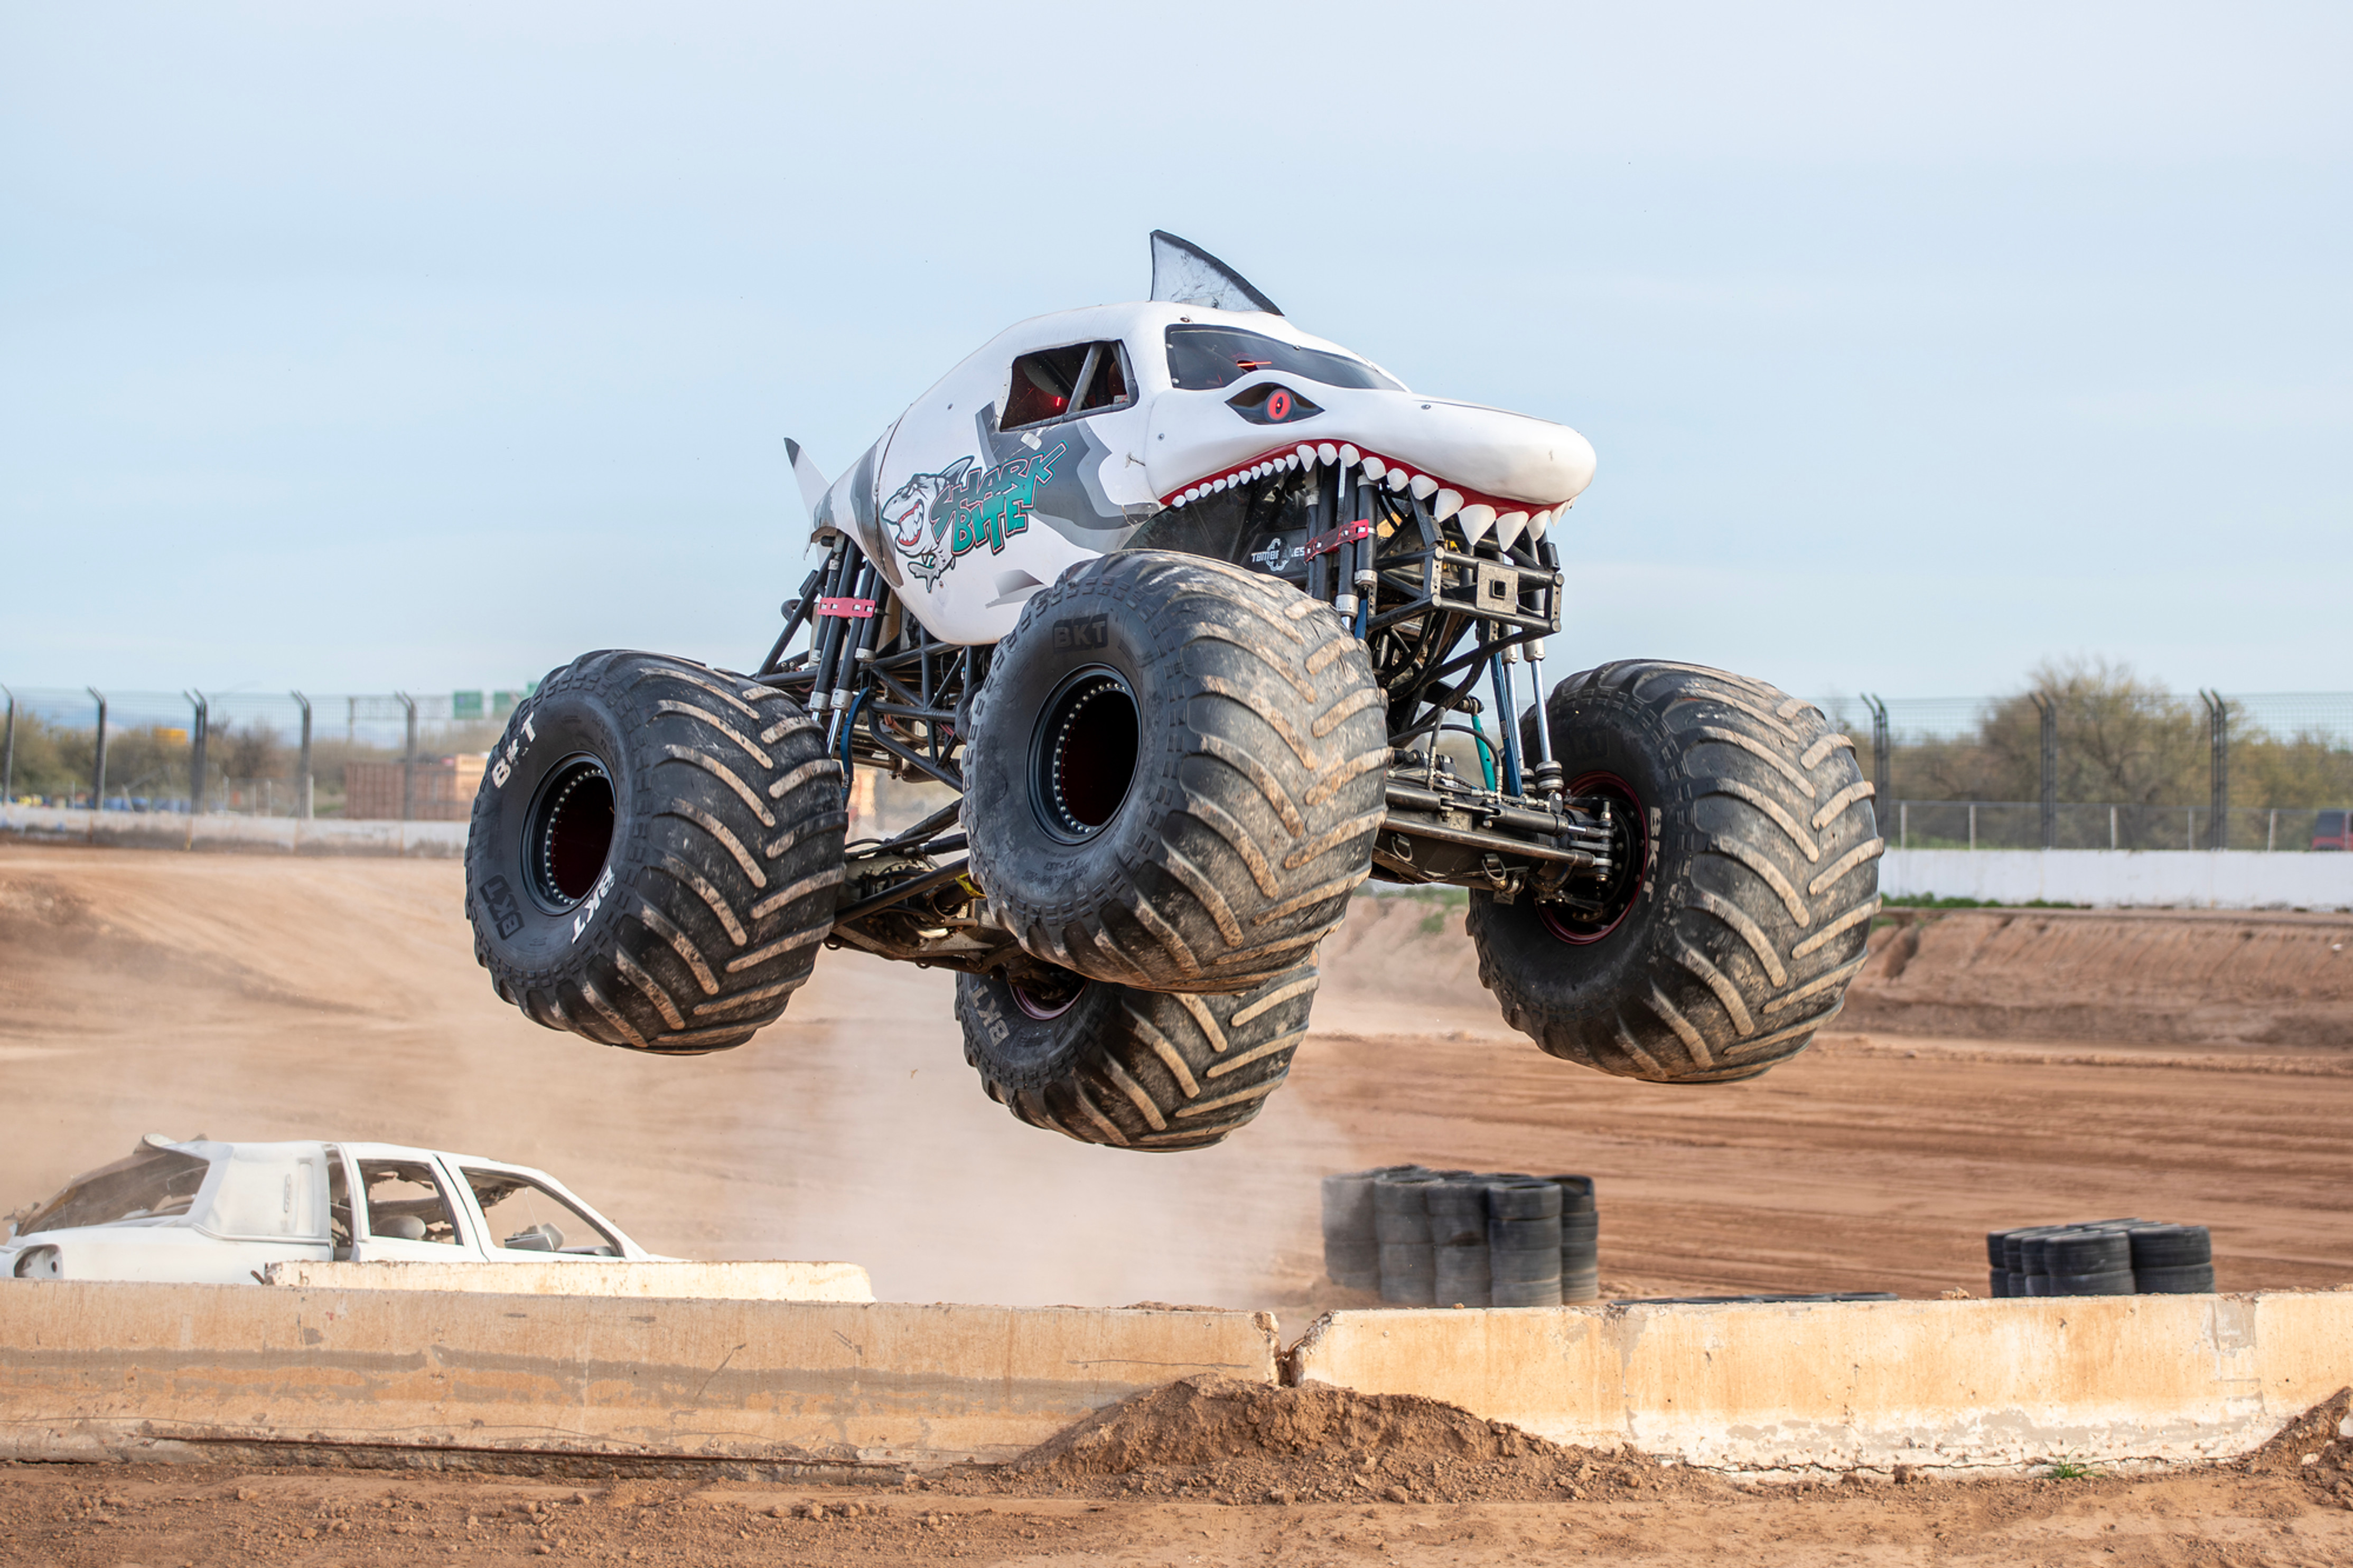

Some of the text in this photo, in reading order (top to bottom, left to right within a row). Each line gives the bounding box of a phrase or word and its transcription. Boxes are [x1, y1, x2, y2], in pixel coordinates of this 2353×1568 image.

[929, 440, 1069, 543] SHARK
[951, 499, 1029, 556] BITE
[1054, 620, 1106, 649] BKT
[491, 711, 536, 789] BKT
[483, 881, 520, 937] BKT
[572, 865, 615, 944] BKT
[972, 984, 1010, 1047] BKT
